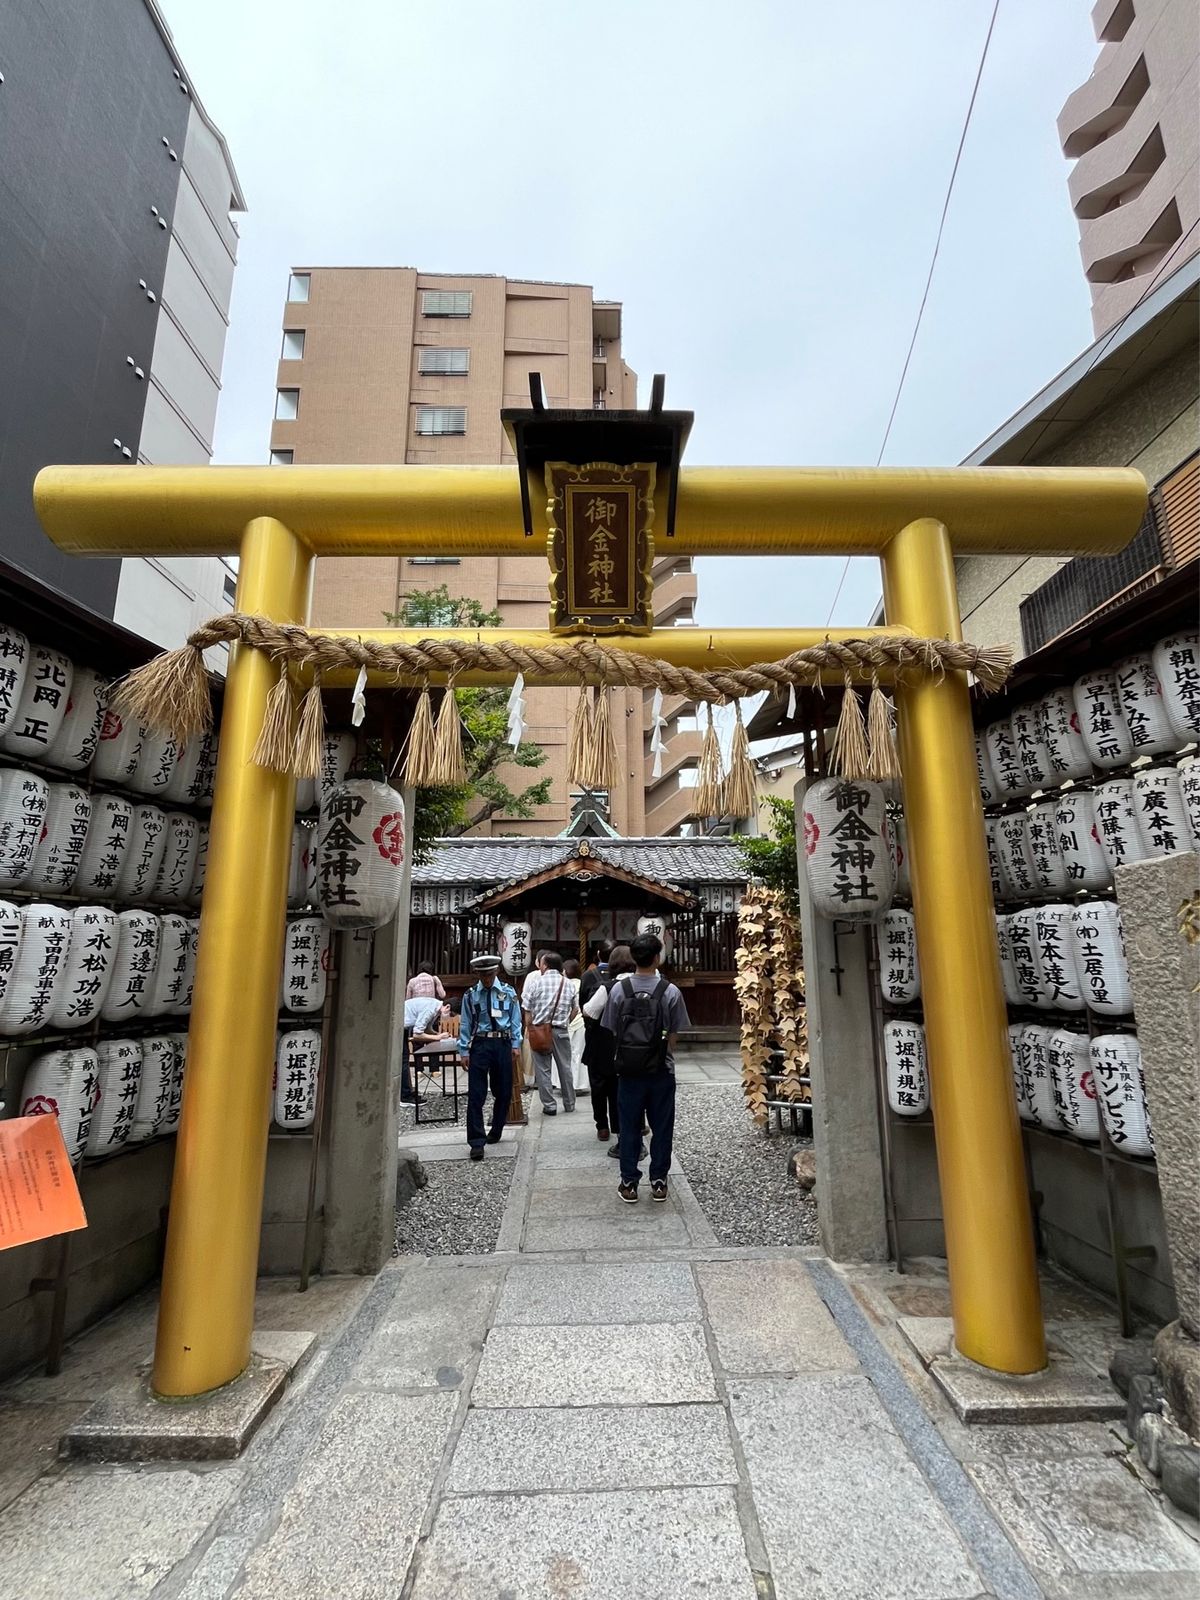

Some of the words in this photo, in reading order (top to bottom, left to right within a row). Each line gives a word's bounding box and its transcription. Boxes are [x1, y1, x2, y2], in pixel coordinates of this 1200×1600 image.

[584, 498, 617, 604] 御金神社
[15, 665, 66, 744] 北岡正
[1085, 685, 1121, 759] 早見雄二郎
[995, 733, 1024, 790] 大真工業
[1137, 777, 1169, 789] 献灯
[23, 780, 49, 797] 献灯
[106, 802, 132, 815] 献灯
[1095, 786, 1122, 796] 献灯
[5, 795, 47, 879] (株)西村測量
[141, 810, 165, 823] 献灯
[172, 818, 195, 829] 献灯
[1142, 790, 1178, 855] 廣本晴
[320, 786, 366, 908] 御金神社
[824, 782, 879, 904] 御金神社
[38, 916, 71, 929] 献灯
[83, 914, 115, 926] 献灯
[129, 917, 157, 928] 献灯
[291, 924, 317, 933] 献灯
[884, 916, 908, 925] 献灯
[1036, 911, 1064, 922] 献灯
[1072, 911, 1098, 921] 献灯
[66, 928, 111, 1018] 永松功浩
[289, 936, 311, 1007] 堀井規隆
[511, 926, 528, 972] 御金神社
[887, 931, 910, 999] 堀井規隆
[1036, 922, 1078, 1000] 阪本達人
[1076, 925, 1113, 1004] (有)土居の里
[18, 932, 65, 1026] 寺田自動車工業所
[286, 1040, 313, 1049] 献灯
[893, 1029, 917, 1038] 献灯
[1091, 1047, 1118, 1059] 献灯
[284, 1053, 309, 1121] 堀井規隆
[895, 1041, 919, 1107] 堀井規隆
[1118, 1061, 1136, 1101] 有限会社
[107, 1061, 142, 1144] 堀井規隆
[1095, 1062, 1128, 1143] サンビック
